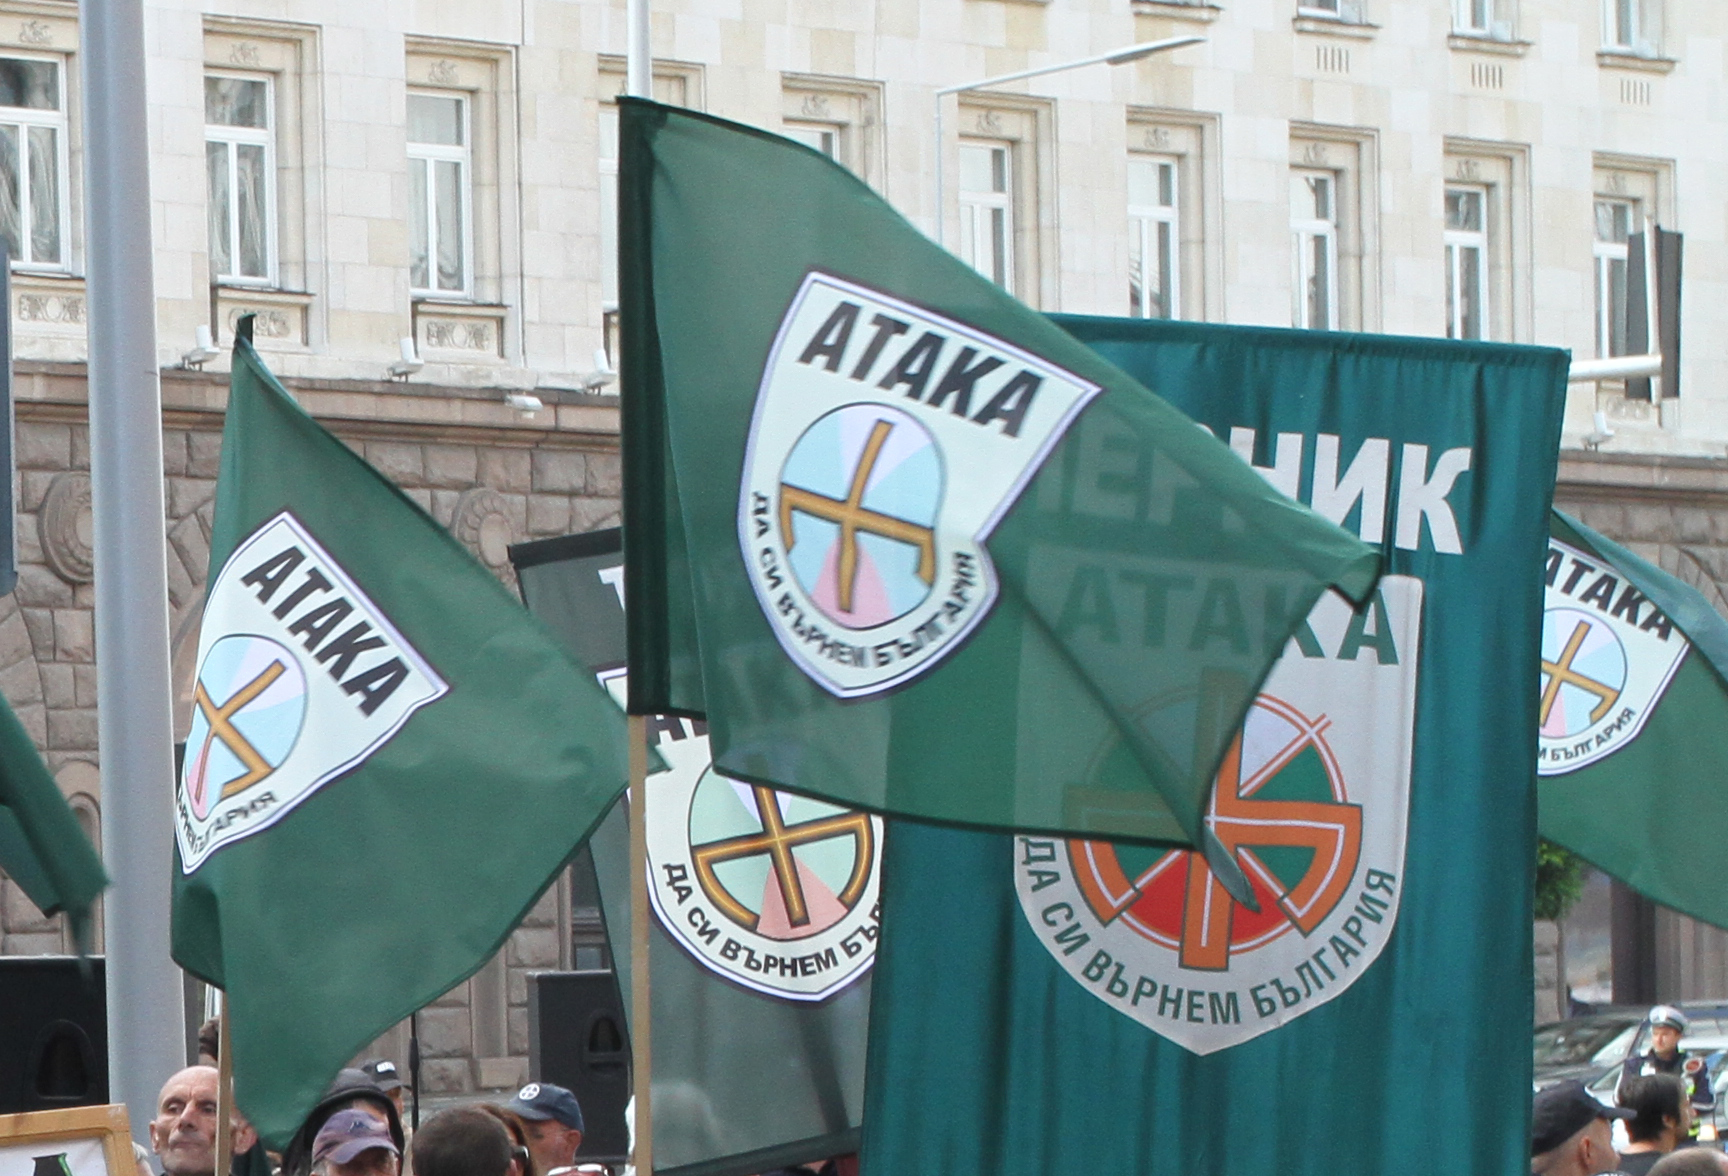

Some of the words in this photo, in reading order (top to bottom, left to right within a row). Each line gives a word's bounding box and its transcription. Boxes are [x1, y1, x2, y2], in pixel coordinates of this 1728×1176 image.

[796, 301, 1046, 438] АТАКА
[241, 546, 411, 718] АТАКА
[872, 551, 976, 667] БЪЛГАРИЯ
[1551, 707, 1636, 761] БЪЛГАРИЯ
[662, 863, 693, 905] ДА
[687, 907, 720, 945] СИ
[720, 938, 839, 978] ВЪРНЕМ
[1020, 837, 1061, 892] ДА
[1042, 901, 1090, 958] СИ
[1081, 949, 1242, 1025] ВЪРНЕМ
[1249, 868, 1397, 1020] БЪЛГАРИЯ
